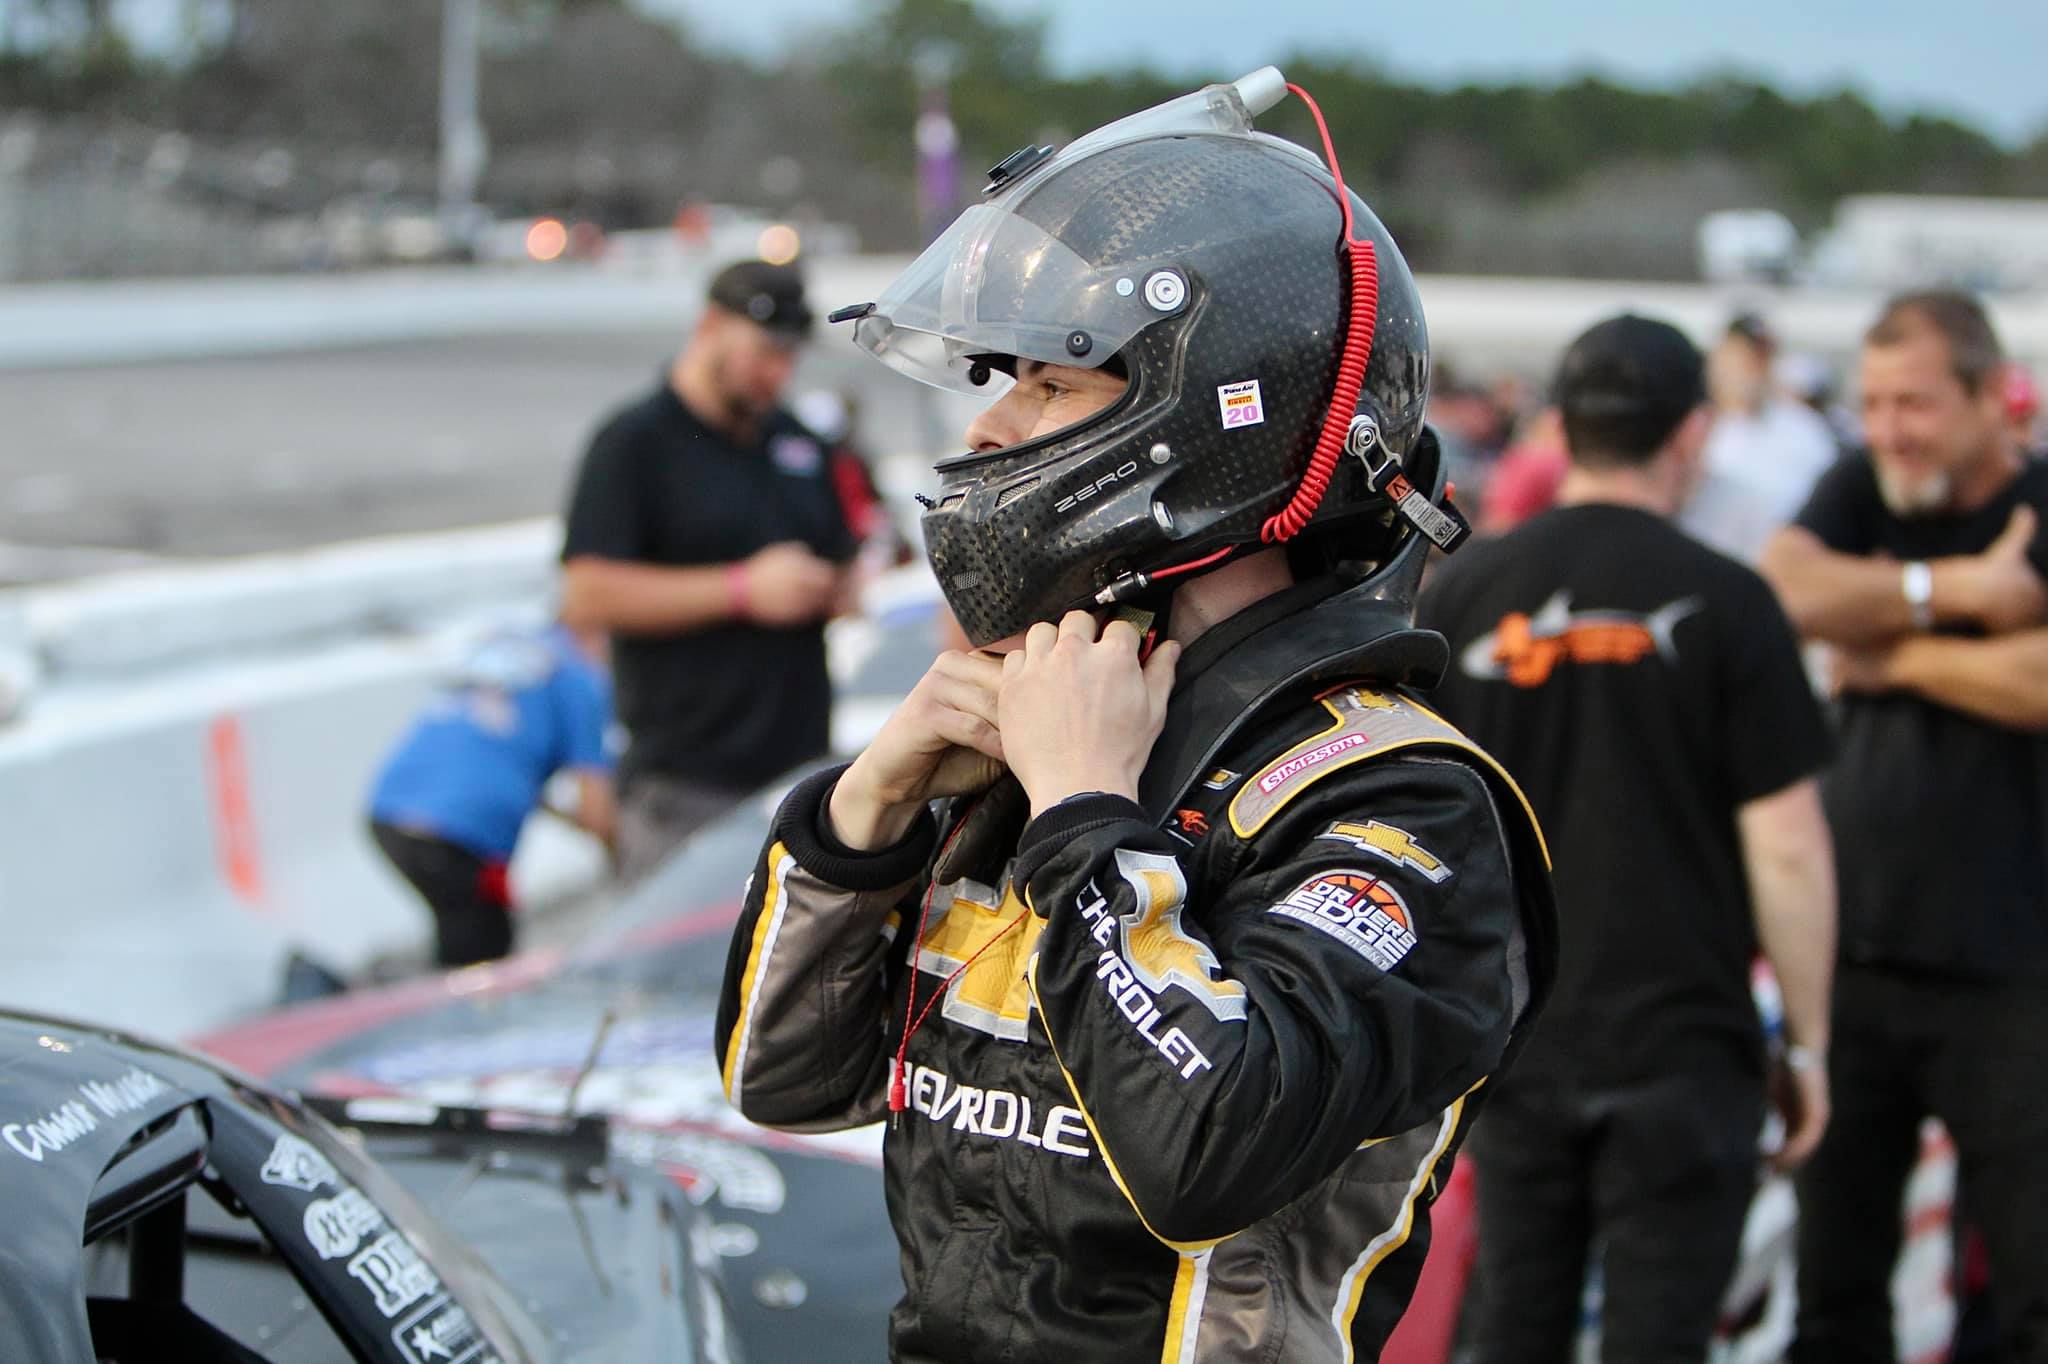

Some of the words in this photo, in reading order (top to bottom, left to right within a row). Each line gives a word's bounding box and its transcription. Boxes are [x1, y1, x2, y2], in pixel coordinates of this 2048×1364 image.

[1226, 405, 1258, 424] 20
[1054, 461, 1137, 513] ZERO
[1267, 738, 1356, 788] SIMPSON
[1286, 889, 1408, 964] EDGE
